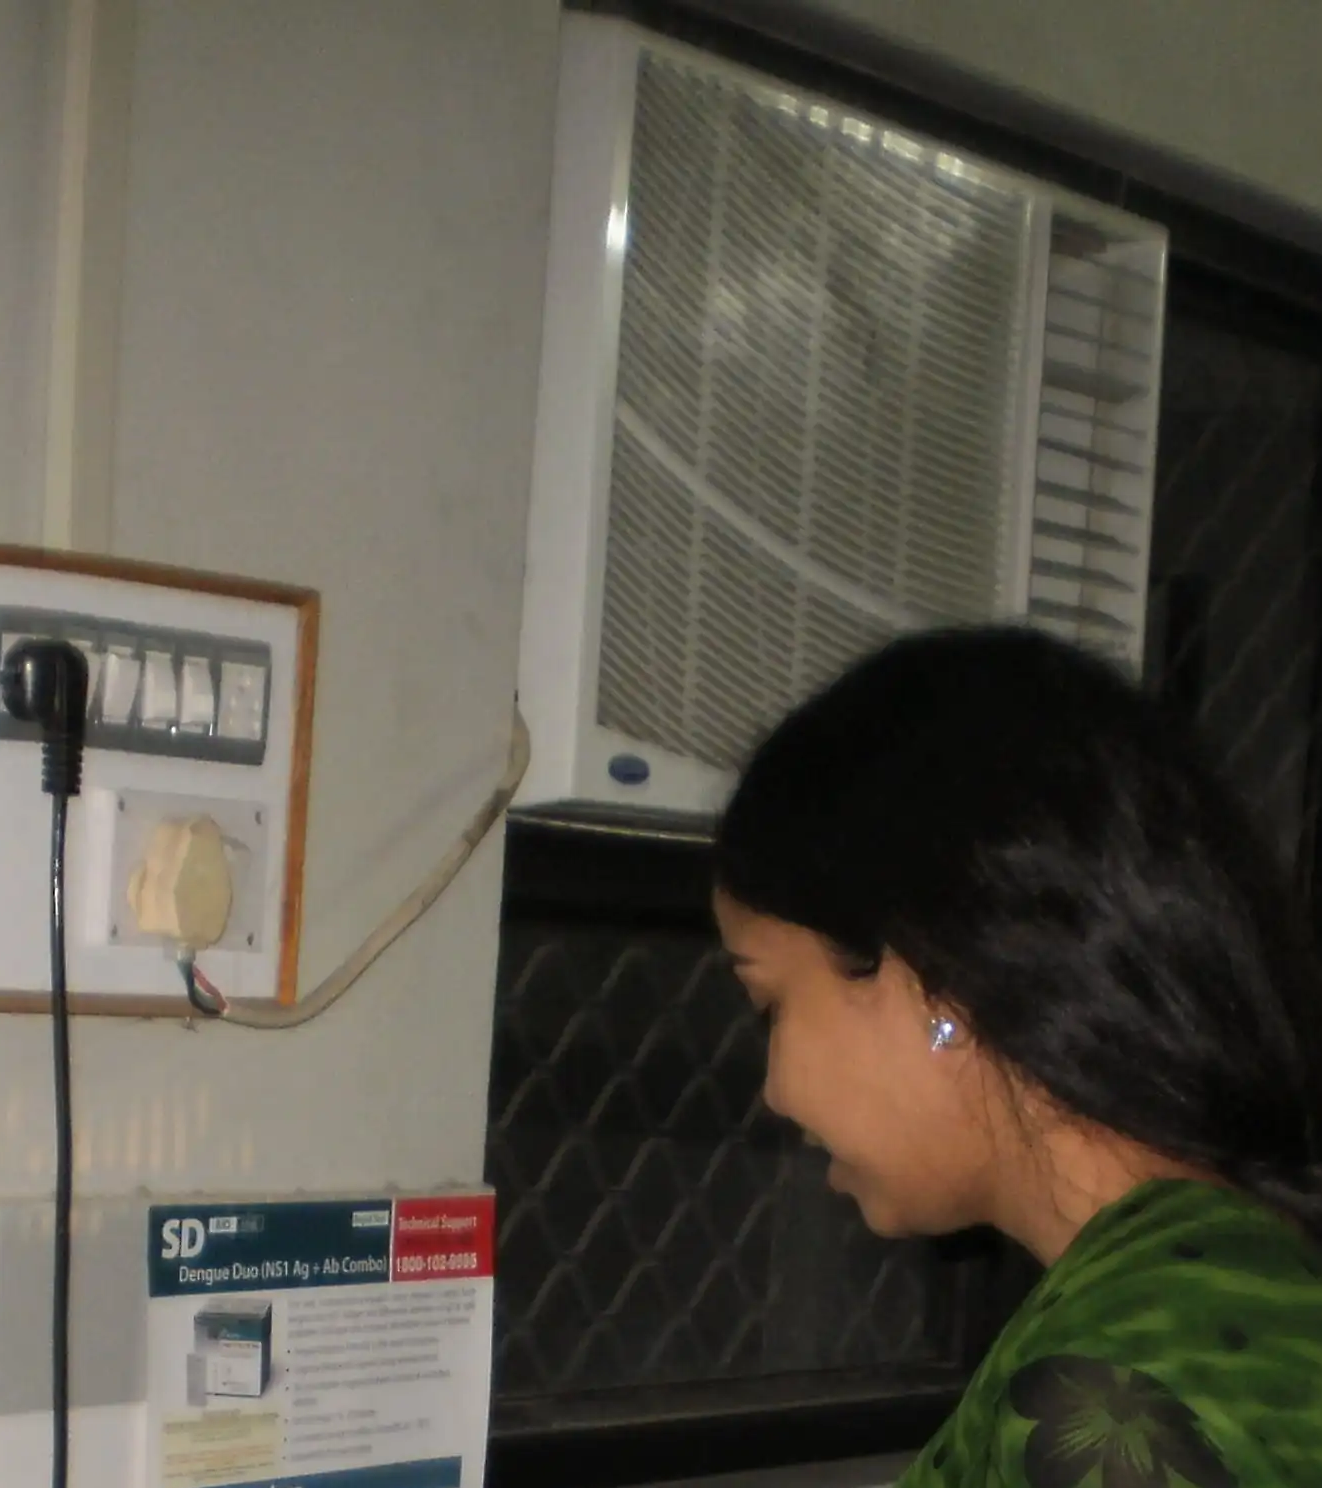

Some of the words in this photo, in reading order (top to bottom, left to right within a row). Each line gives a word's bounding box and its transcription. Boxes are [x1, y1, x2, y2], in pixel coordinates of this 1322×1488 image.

[161, 1217, 205, 1259] SD
[398, 1215, 439, 1230] Technical
[441, 1214, 477, 1232] Support
[179, 1265, 229, 1286] Dengue
[232, 1262, 259, 1280] Duo
[261, 1259, 289, 1280] (NS1
[293, 1260, 309, 1280] Ag
[323, 1256, 339, 1274] Ab
[341, 1254, 387, 1274] Combo)
